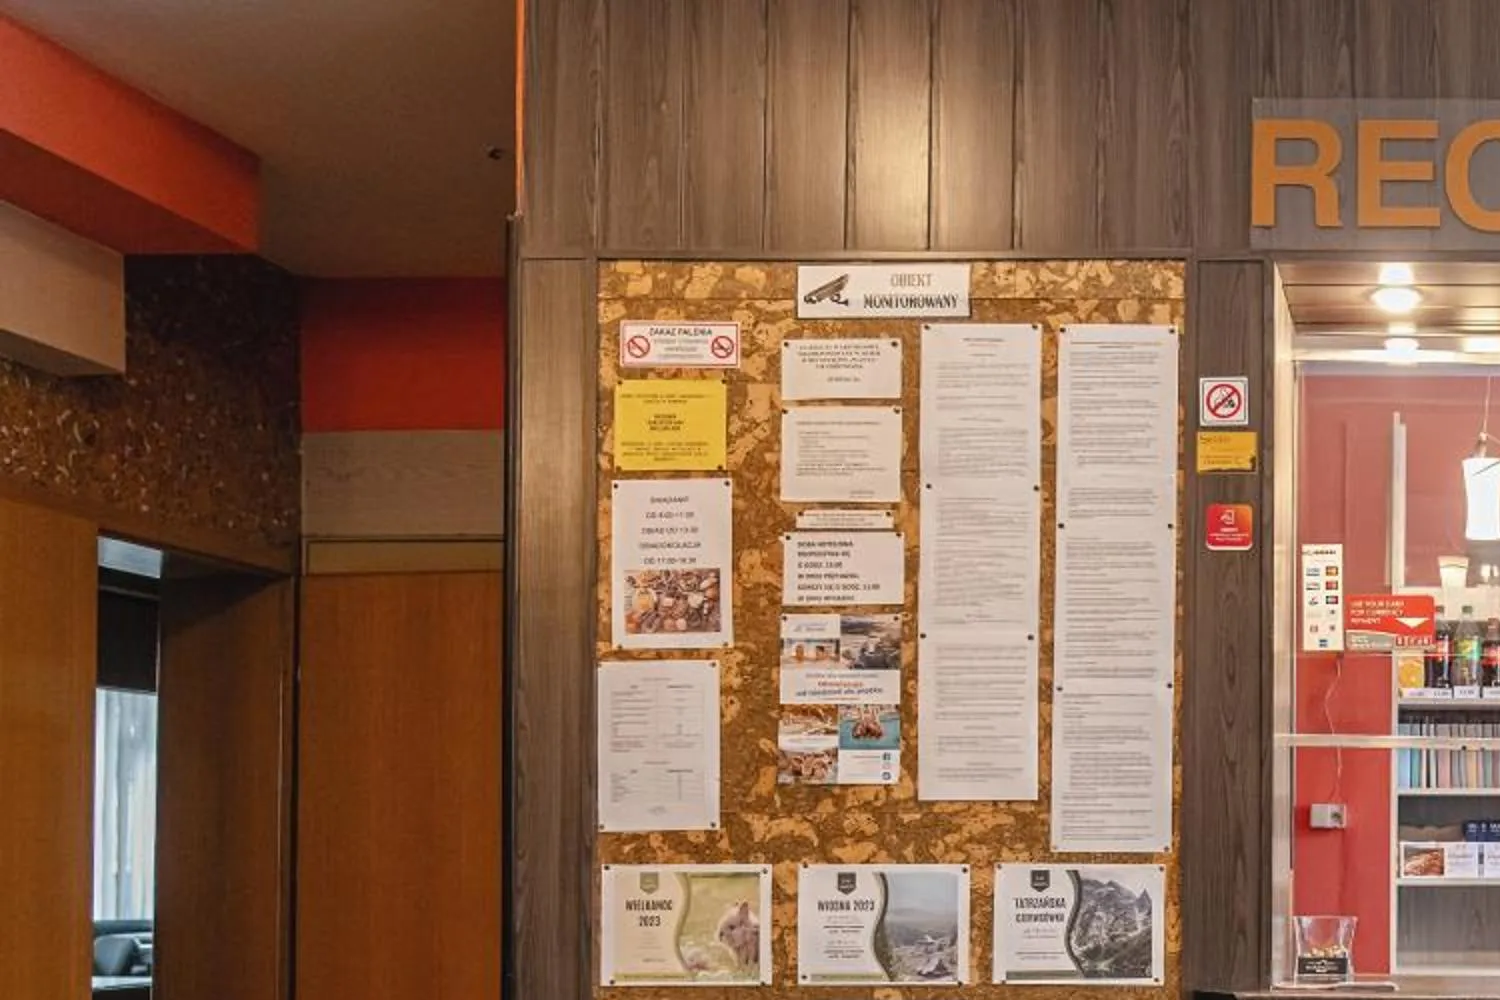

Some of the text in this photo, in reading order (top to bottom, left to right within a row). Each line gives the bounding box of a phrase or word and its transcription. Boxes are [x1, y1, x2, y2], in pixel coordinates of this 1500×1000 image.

[890, 273, 933, 287] OBIEKT
[863, 293, 959, 309] MONITOROWANY
[649, 327, 713, 336] ZAKAZ PALENIA
[625, 899, 673, 911] WIELKANOC
[817, 899, 876, 912] WIOSNA 2023
[639, 915, 661, 927] 2023
